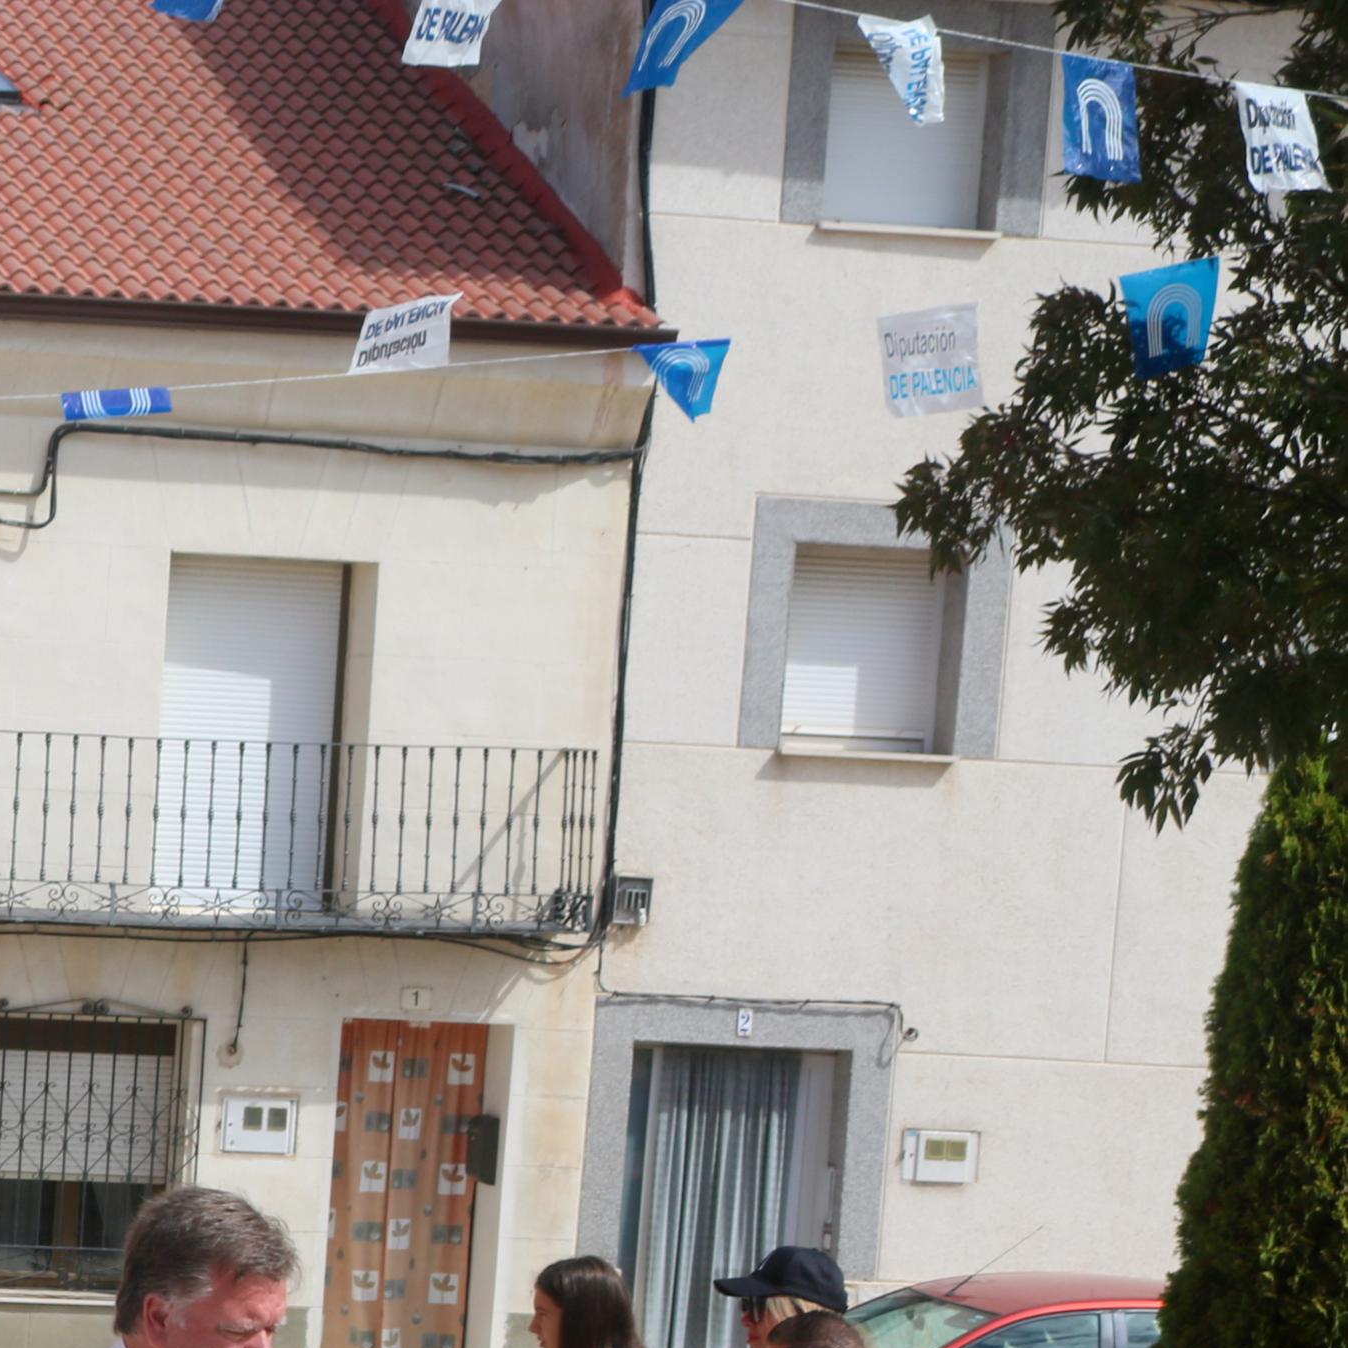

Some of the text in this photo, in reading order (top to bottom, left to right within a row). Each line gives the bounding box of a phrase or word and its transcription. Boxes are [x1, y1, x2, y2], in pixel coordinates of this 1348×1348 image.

[1250, 145, 1273, 175] DE
[884, 326, 957, 363] Diputación
[889, 365, 978, 401] DE PALENCIA
[740, 1013, 750, 1032] 2
